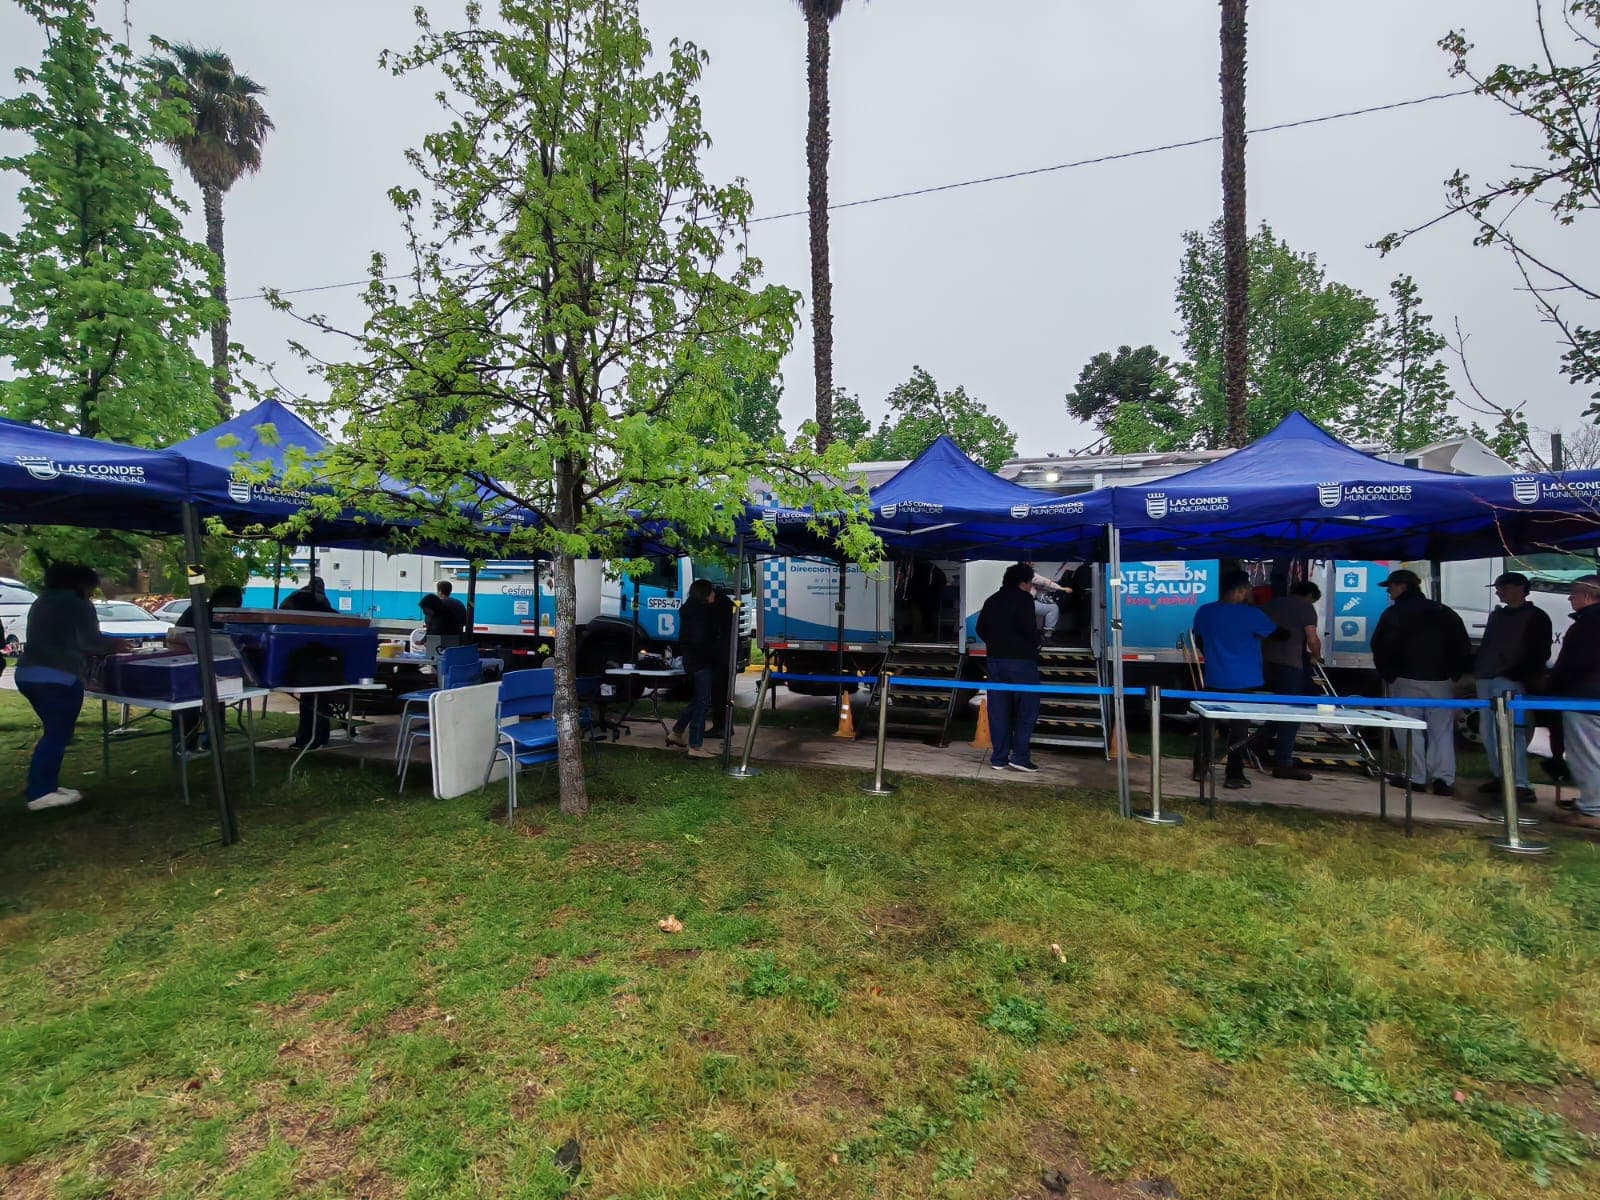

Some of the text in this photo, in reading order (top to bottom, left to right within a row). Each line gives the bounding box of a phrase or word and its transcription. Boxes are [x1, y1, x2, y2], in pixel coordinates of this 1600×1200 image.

[58, 464, 144, 476] LAS CONDES
[1345, 485, 1412, 495] LAS CONDES
[1542, 481, 1600, 491] LAS COND
[1169, 496, 1229, 507] LAS CONDES
[1344, 493, 1412, 502] MUNICIPALIDAD
[899, 500, 913, 508] LAS
[1169, 504, 1229, 512] MUNICIPALIDAD
[1030, 506, 1084, 515] MUNICIPALIDAD
[501, 584, 534, 596] Cesfam
[1144, 581, 1207, 595] SALUD
[648, 599, 681, 609] SFPS-47
